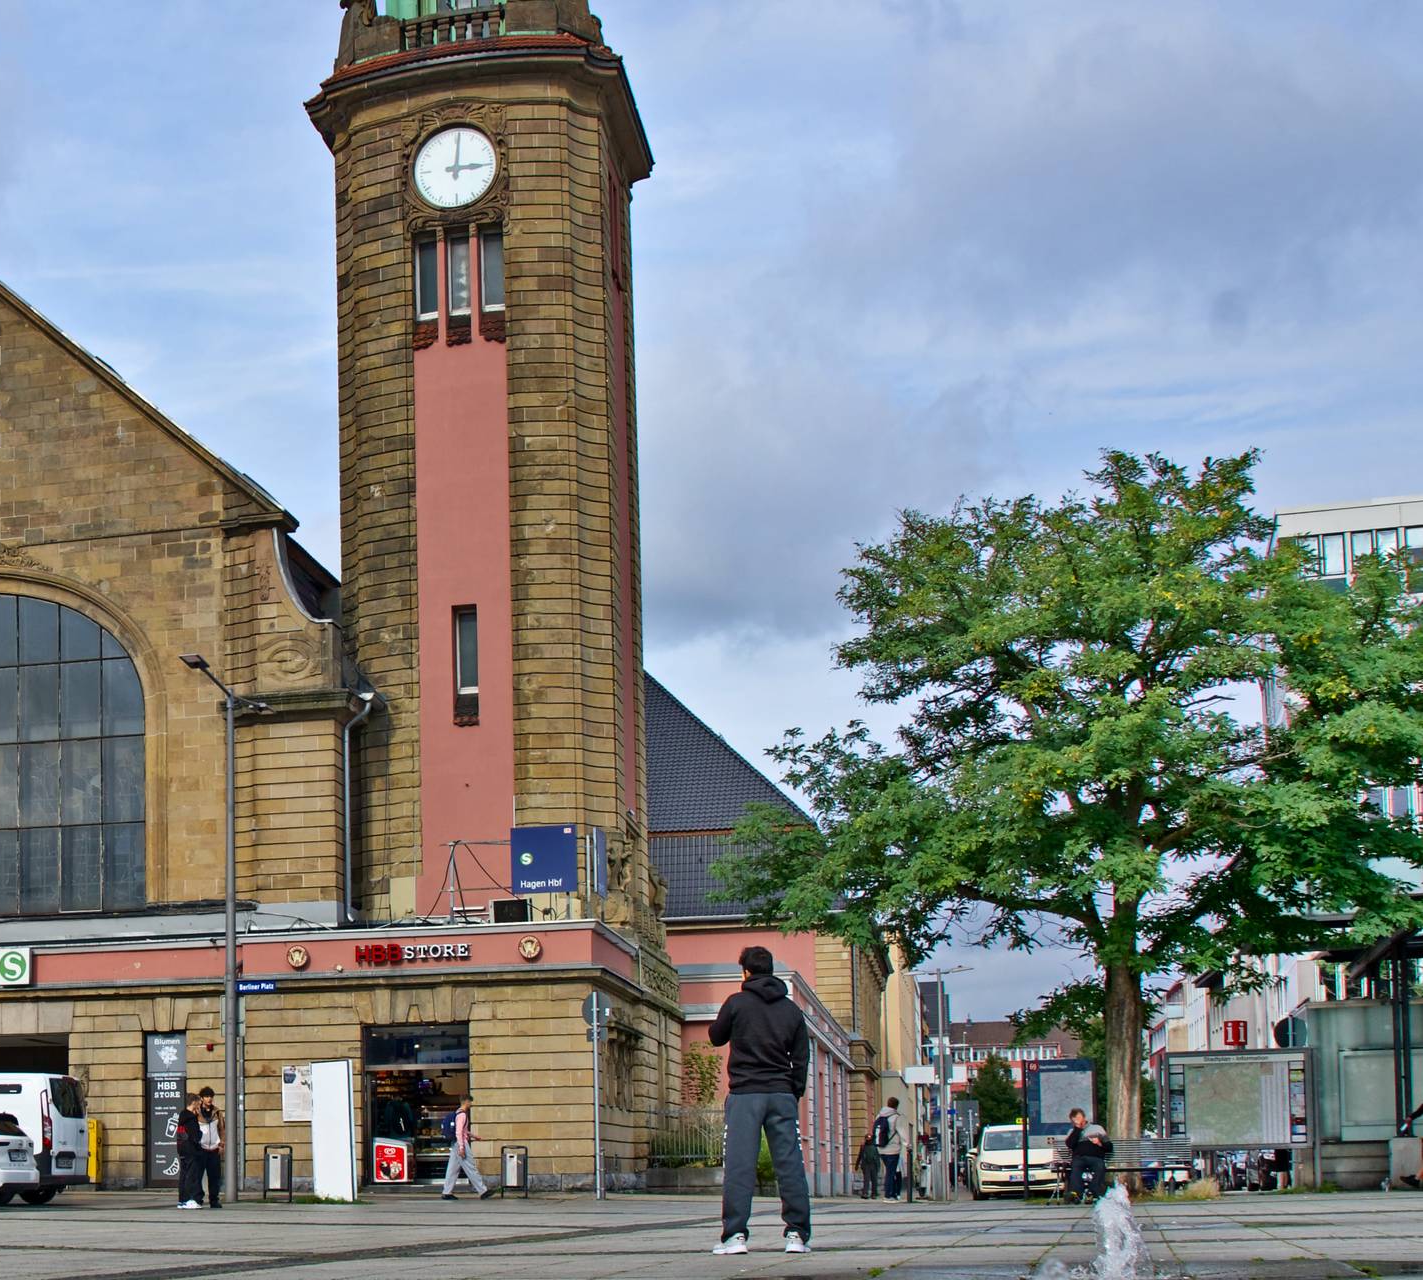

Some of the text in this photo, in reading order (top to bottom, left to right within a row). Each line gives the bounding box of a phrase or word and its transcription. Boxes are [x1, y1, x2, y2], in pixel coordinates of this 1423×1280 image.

[520, 878, 562, 889] Hagen Hbf
[355, 943, 470, 963] HBB STORE
[261, 982, 274, 990] Platz
[157, 1082, 177, 1090] HBB
